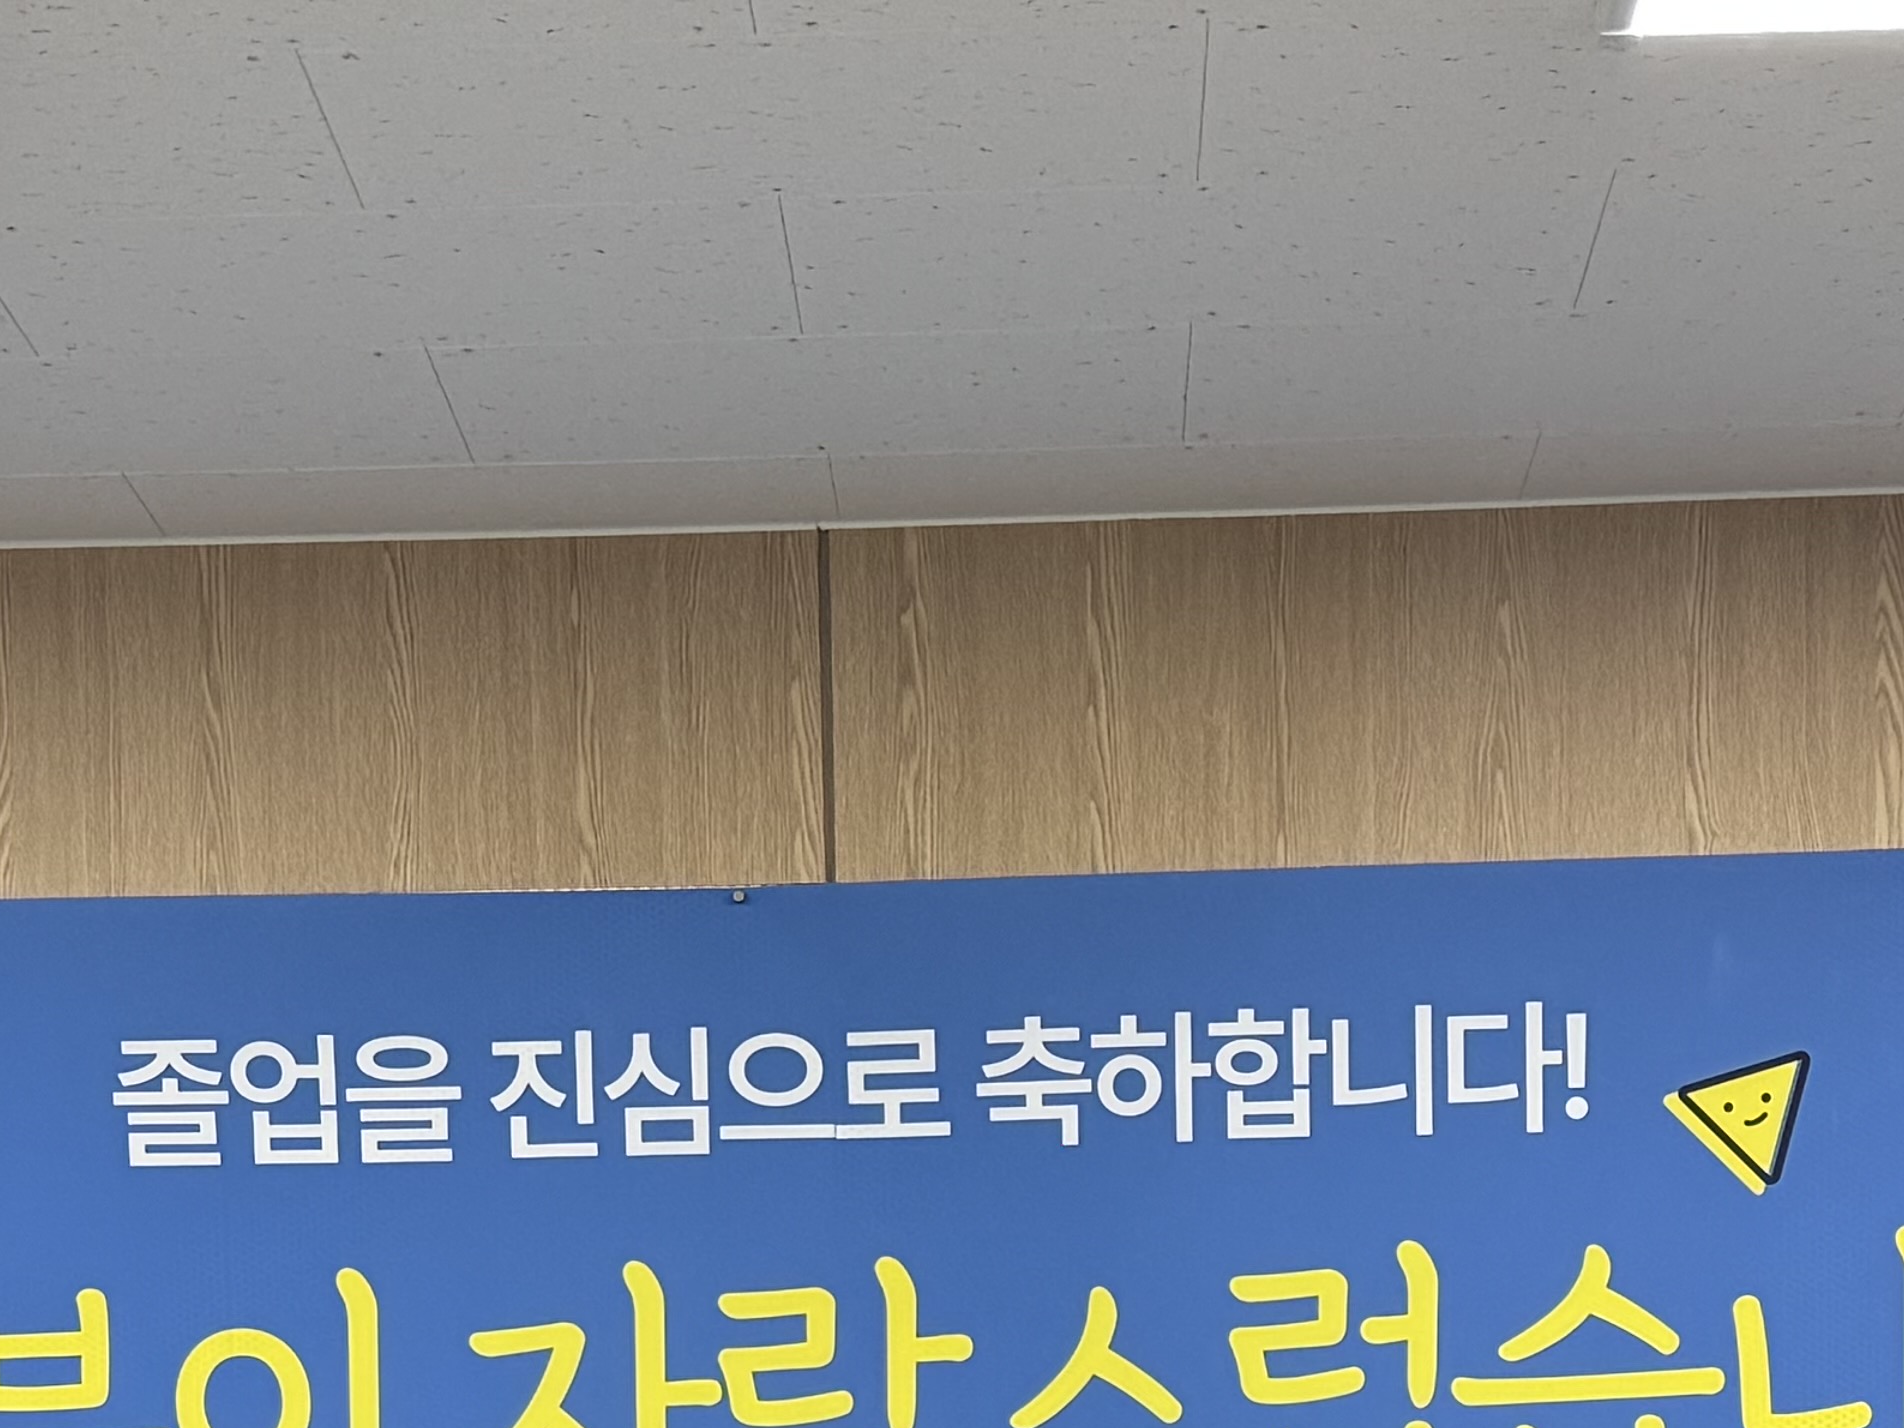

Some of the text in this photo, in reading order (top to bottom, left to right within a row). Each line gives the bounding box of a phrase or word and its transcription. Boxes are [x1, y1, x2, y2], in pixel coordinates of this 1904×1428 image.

[112, 1001, 1589, 1167] 졸업을 진심으로 축하합니다!
